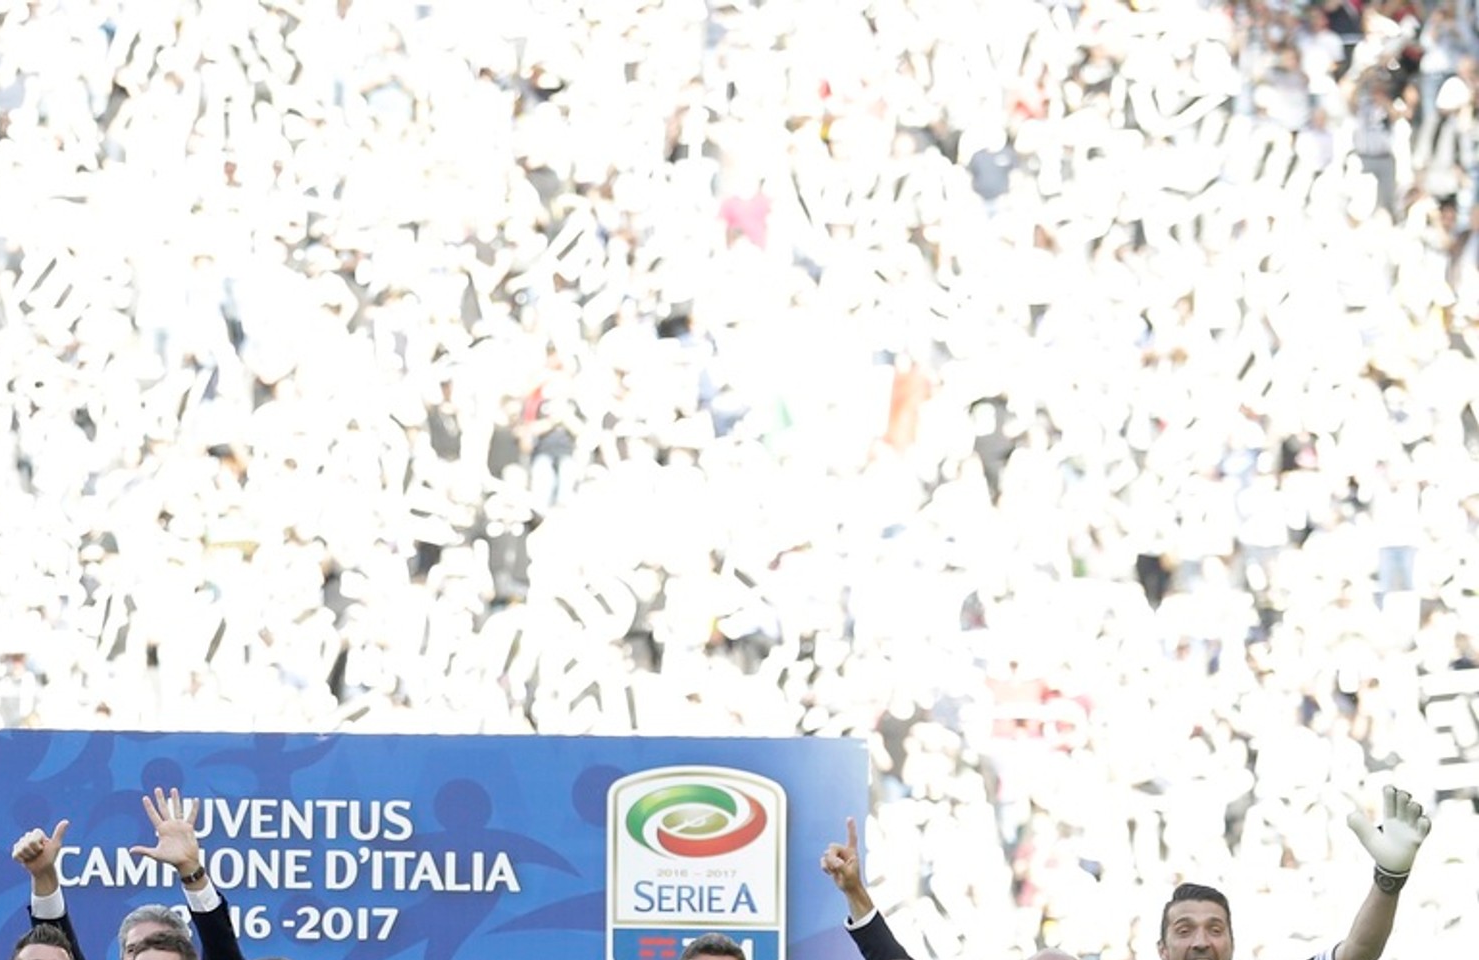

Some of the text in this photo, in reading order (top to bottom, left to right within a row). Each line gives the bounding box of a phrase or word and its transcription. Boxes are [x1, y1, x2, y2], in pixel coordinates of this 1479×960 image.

[325, 847, 521, 893] D'ITALIA
[657, 868, 737, 879] 2016 2017
[634, 880, 758, 914] SERIE A
